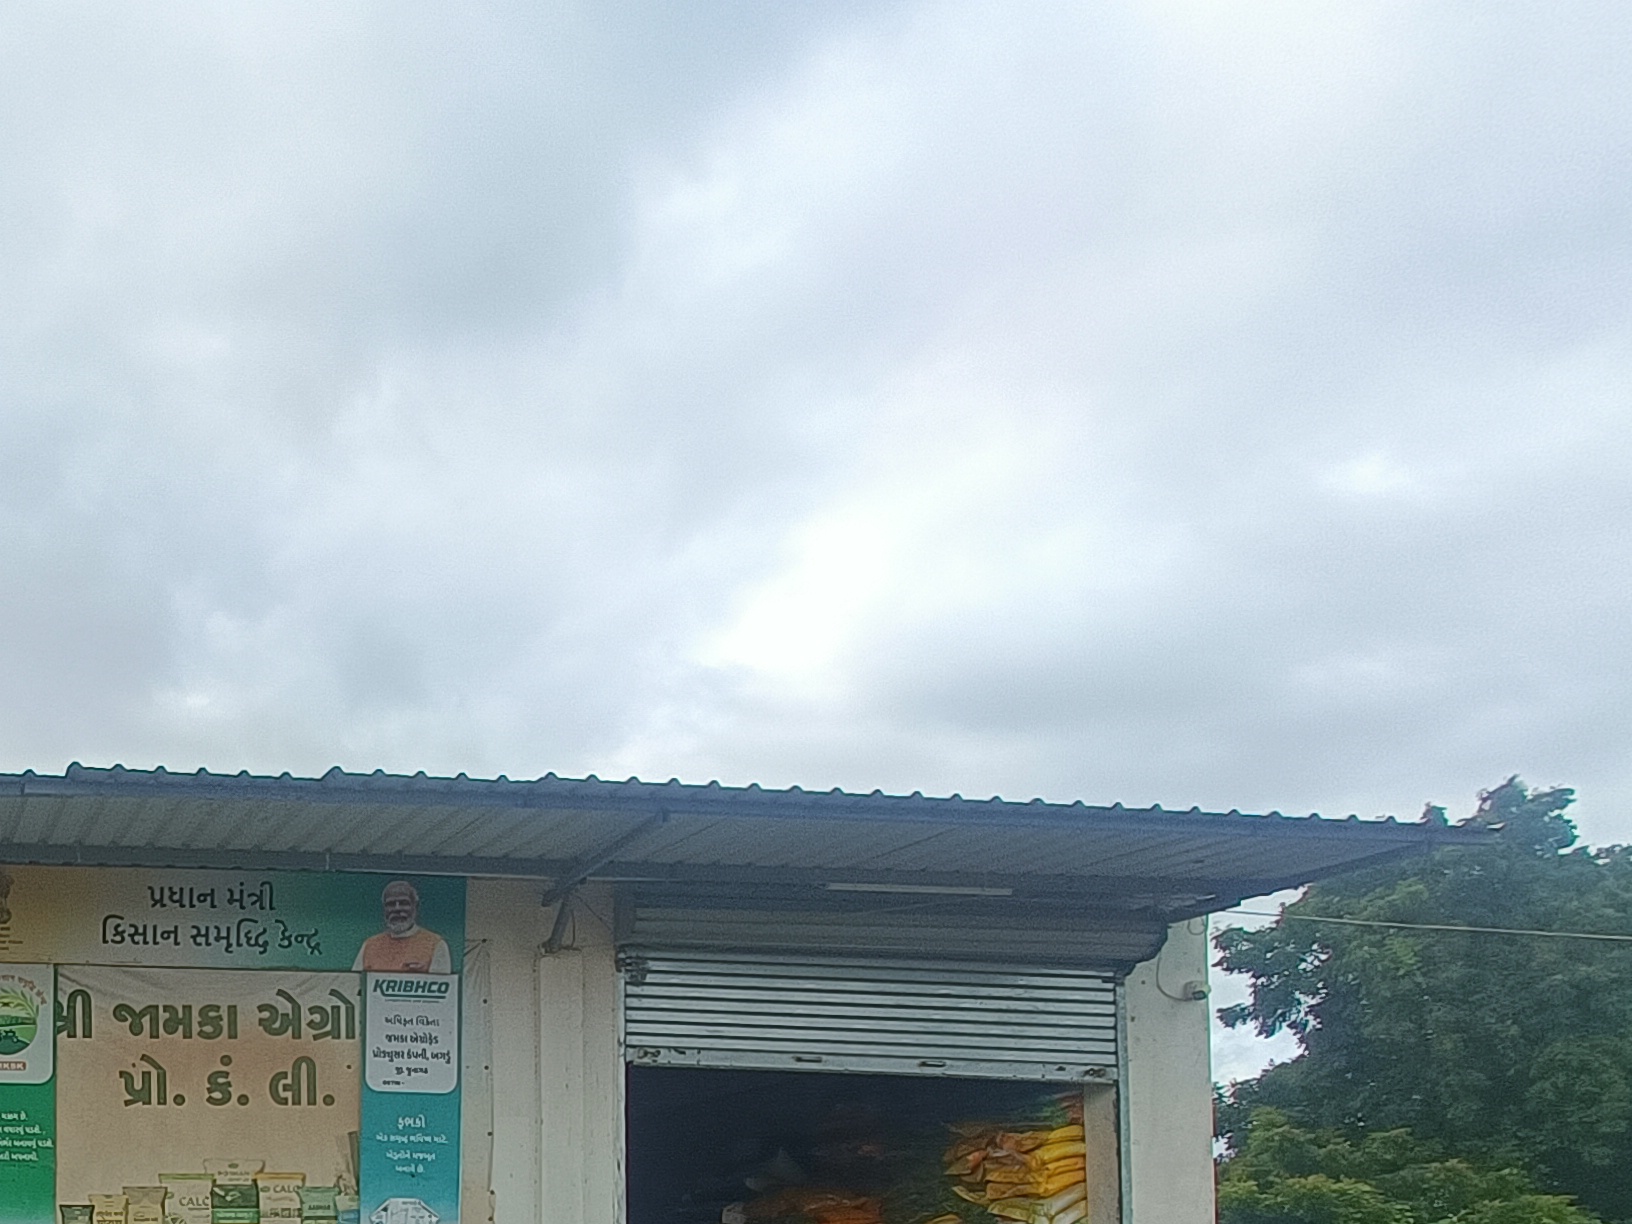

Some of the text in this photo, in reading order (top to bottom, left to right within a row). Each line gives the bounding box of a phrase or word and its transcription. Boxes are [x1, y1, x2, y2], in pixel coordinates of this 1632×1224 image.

[147, 880, 277, 911] પ્રધાન મંત્રી
[101, 914, 181, 946] કિસાન
[274, 918, 323, 955] કેન્દ્ર
[372, 979, 450, 996] KRIBHCO
[112, 1002, 239, 1041] જામકા
[118, 1053, 336, 1108] પ્રો. કં. લી.
